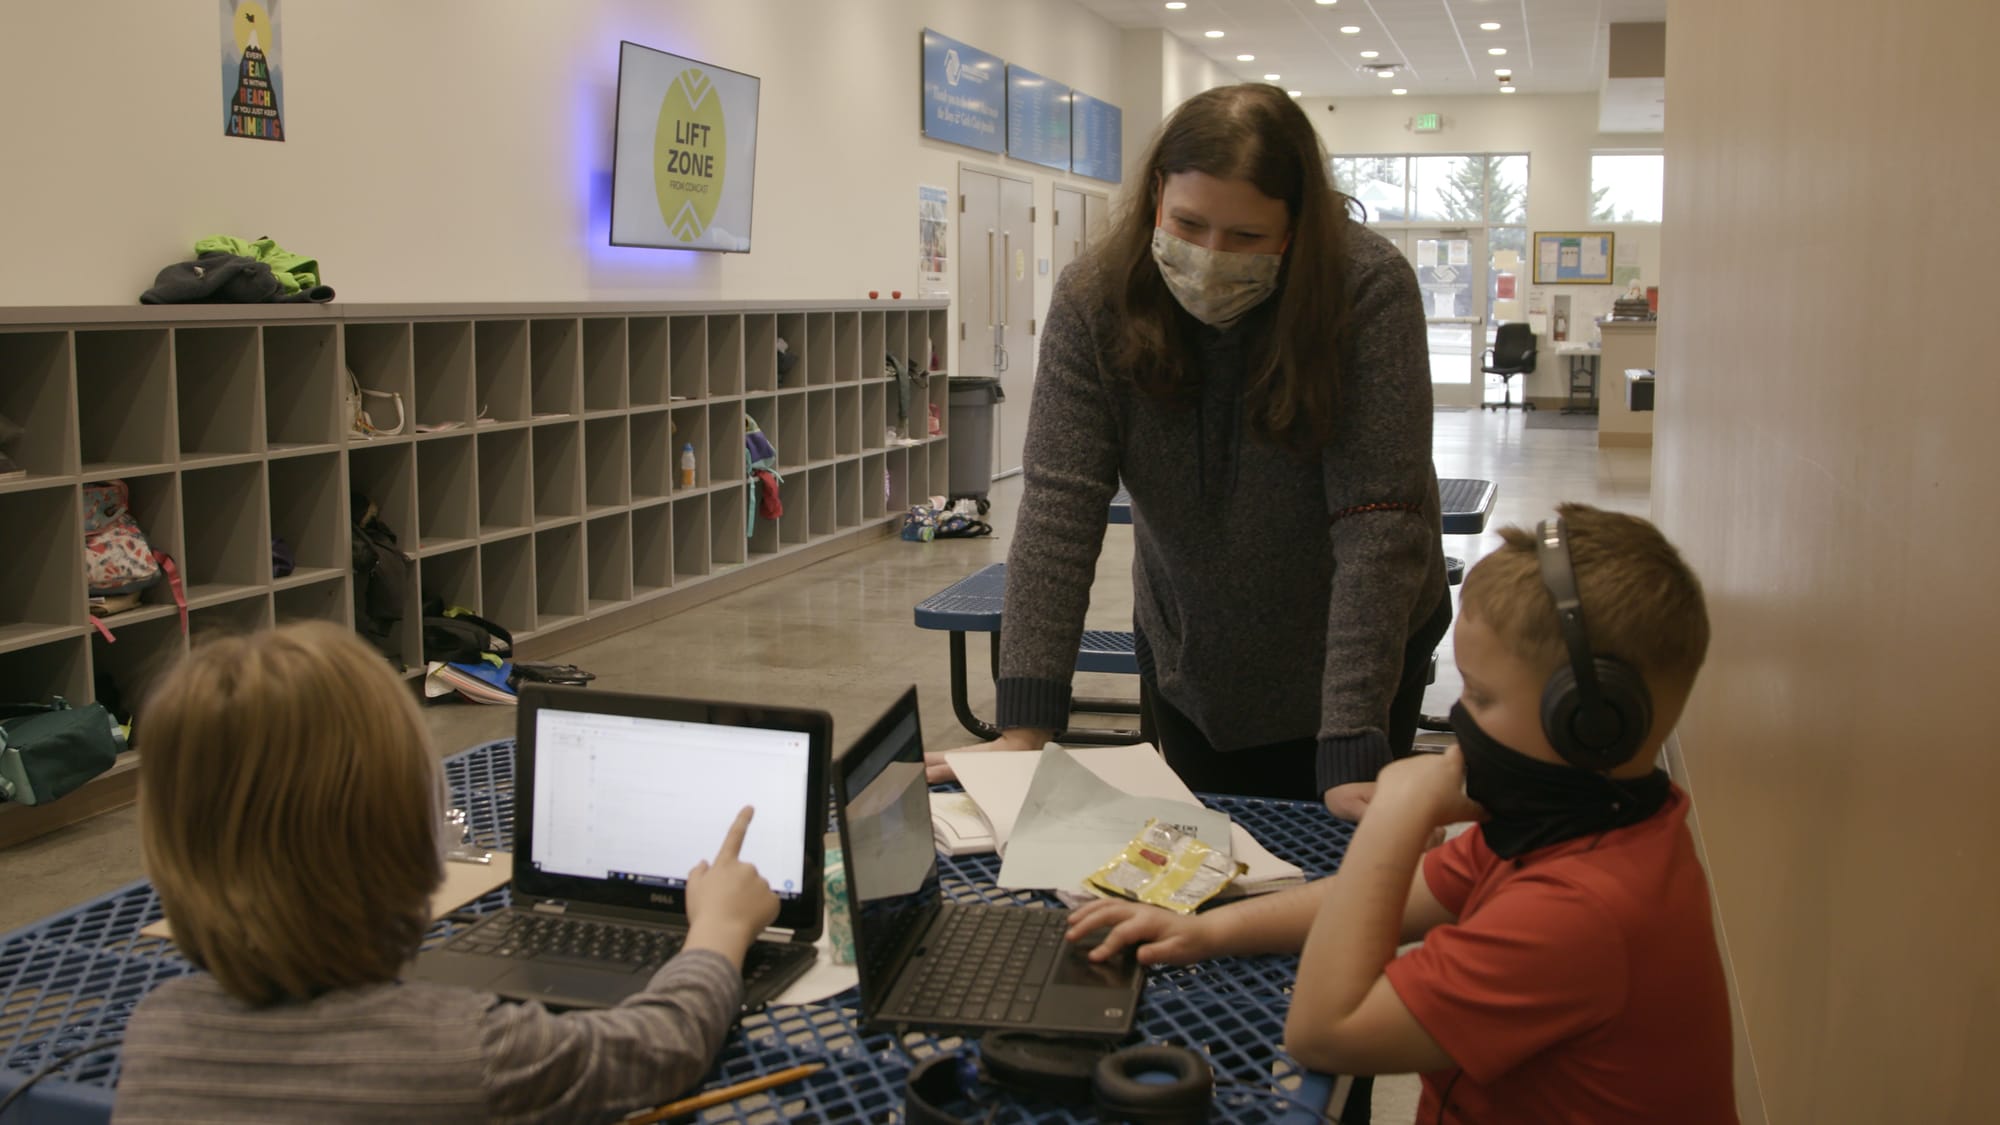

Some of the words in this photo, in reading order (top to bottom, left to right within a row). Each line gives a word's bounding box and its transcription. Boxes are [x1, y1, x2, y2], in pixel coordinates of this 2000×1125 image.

[246, 51, 262, 59] EVERY
[242, 60, 266, 78] PEAK
[240, 87, 270, 106] REACH
[240, 106, 251, 114] YOU
[252, 107, 263, 115] JUST
[232, 114, 280, 137] CLIMBING
[1416, 113, 1436, 129] EXIT
[676, 119, 711, 148] LIFT
[667, 149, 713, 178] ZONE
[650, 892, 674, 905] DELL
